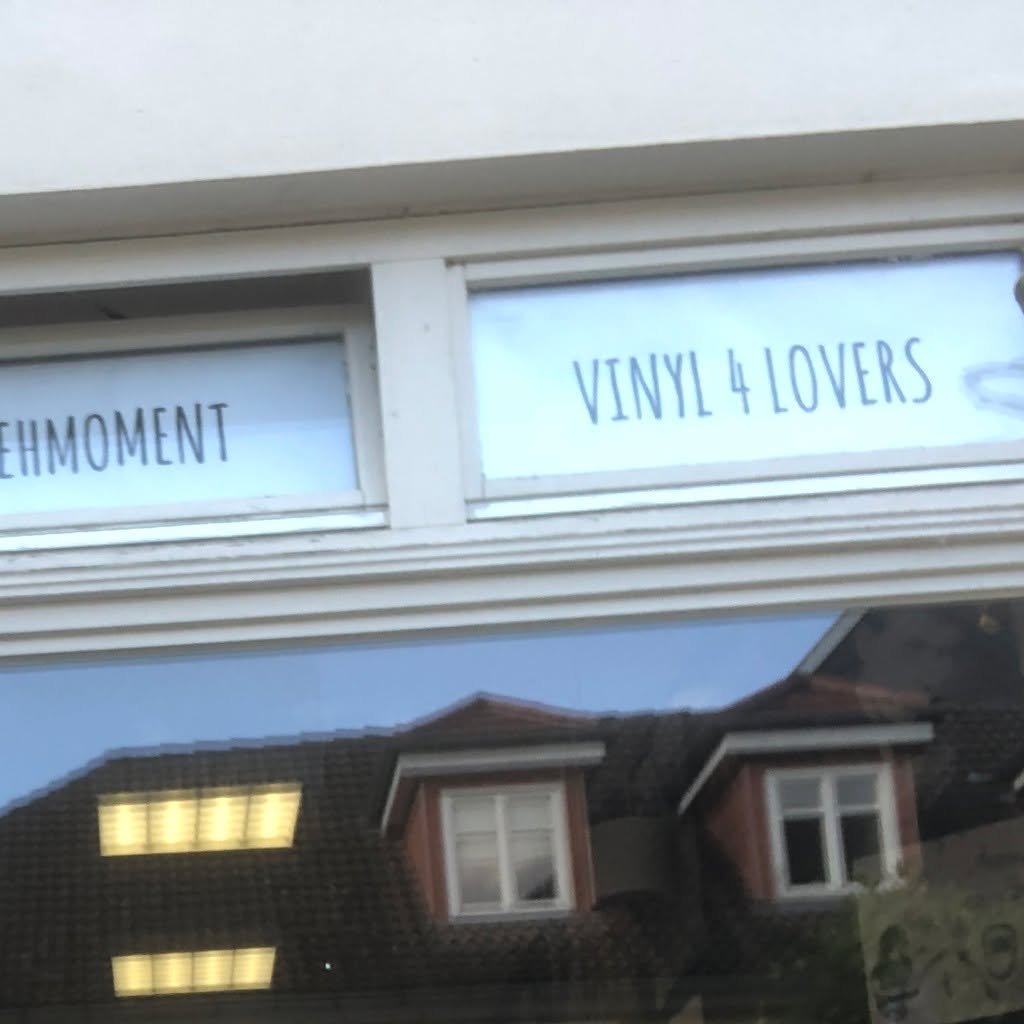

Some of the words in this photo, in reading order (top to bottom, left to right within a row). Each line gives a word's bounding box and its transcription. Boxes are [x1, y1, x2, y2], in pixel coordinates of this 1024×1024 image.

[573, 350, 713, 425] VINYL
[727, 348, 751, 415] 4
[764, 337, 933, 414] LOVERS
